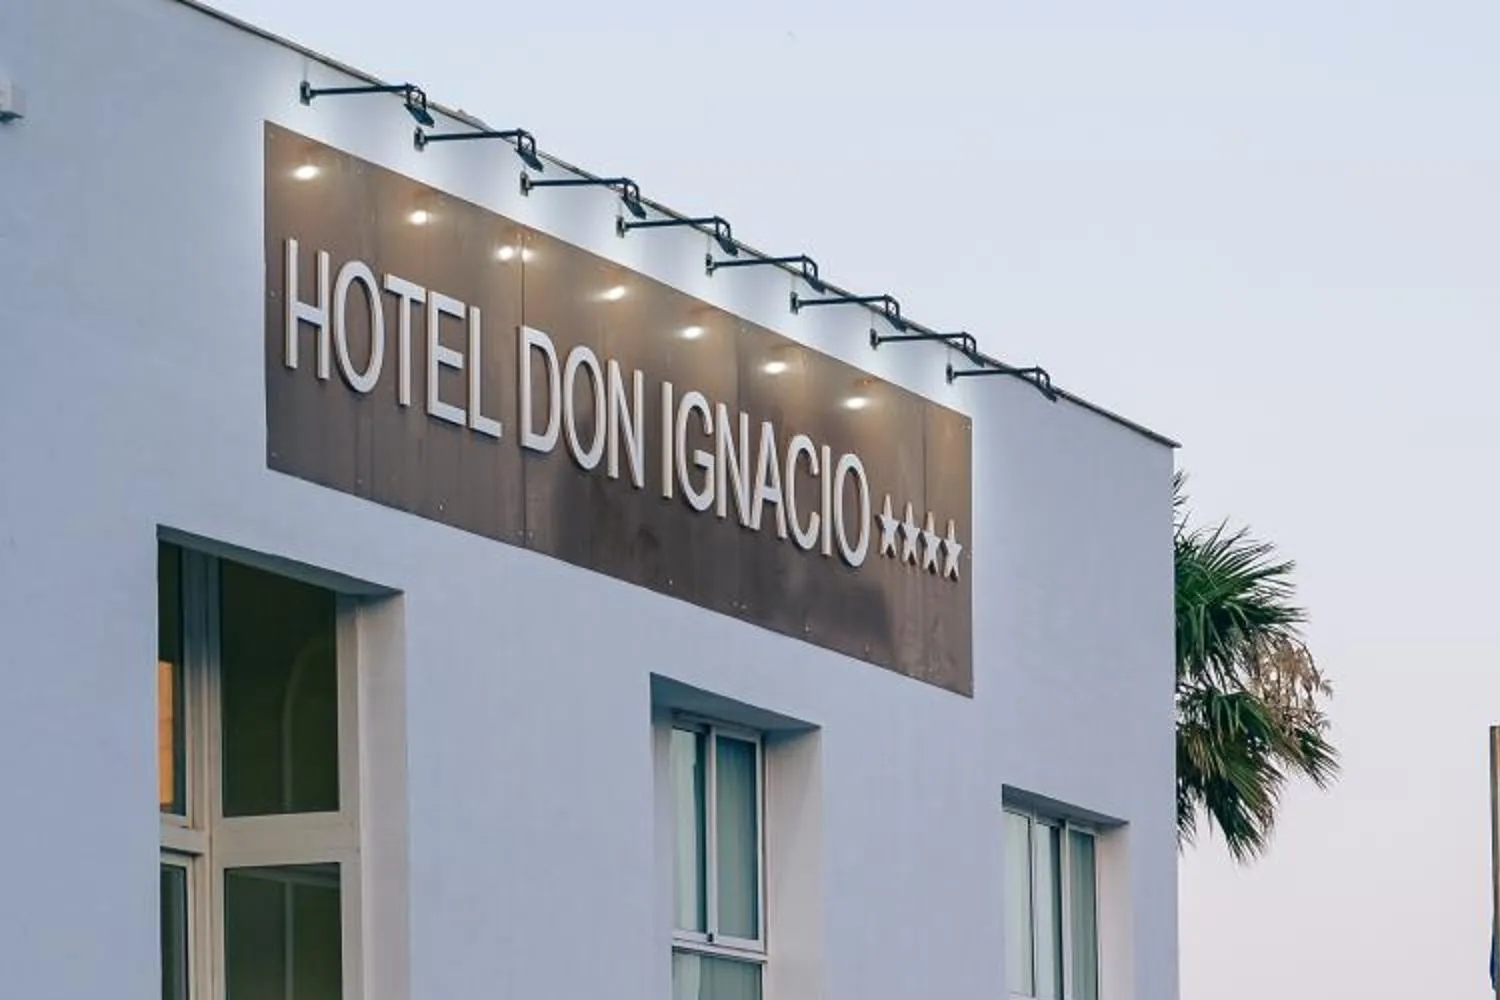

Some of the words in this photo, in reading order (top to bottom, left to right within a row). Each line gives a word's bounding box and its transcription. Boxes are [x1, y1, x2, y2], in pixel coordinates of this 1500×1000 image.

[284, 238, 503, 439] HOTEL
[518, 324, 646, 490] DON
[661, 380, 872, 569] IGNACIO
